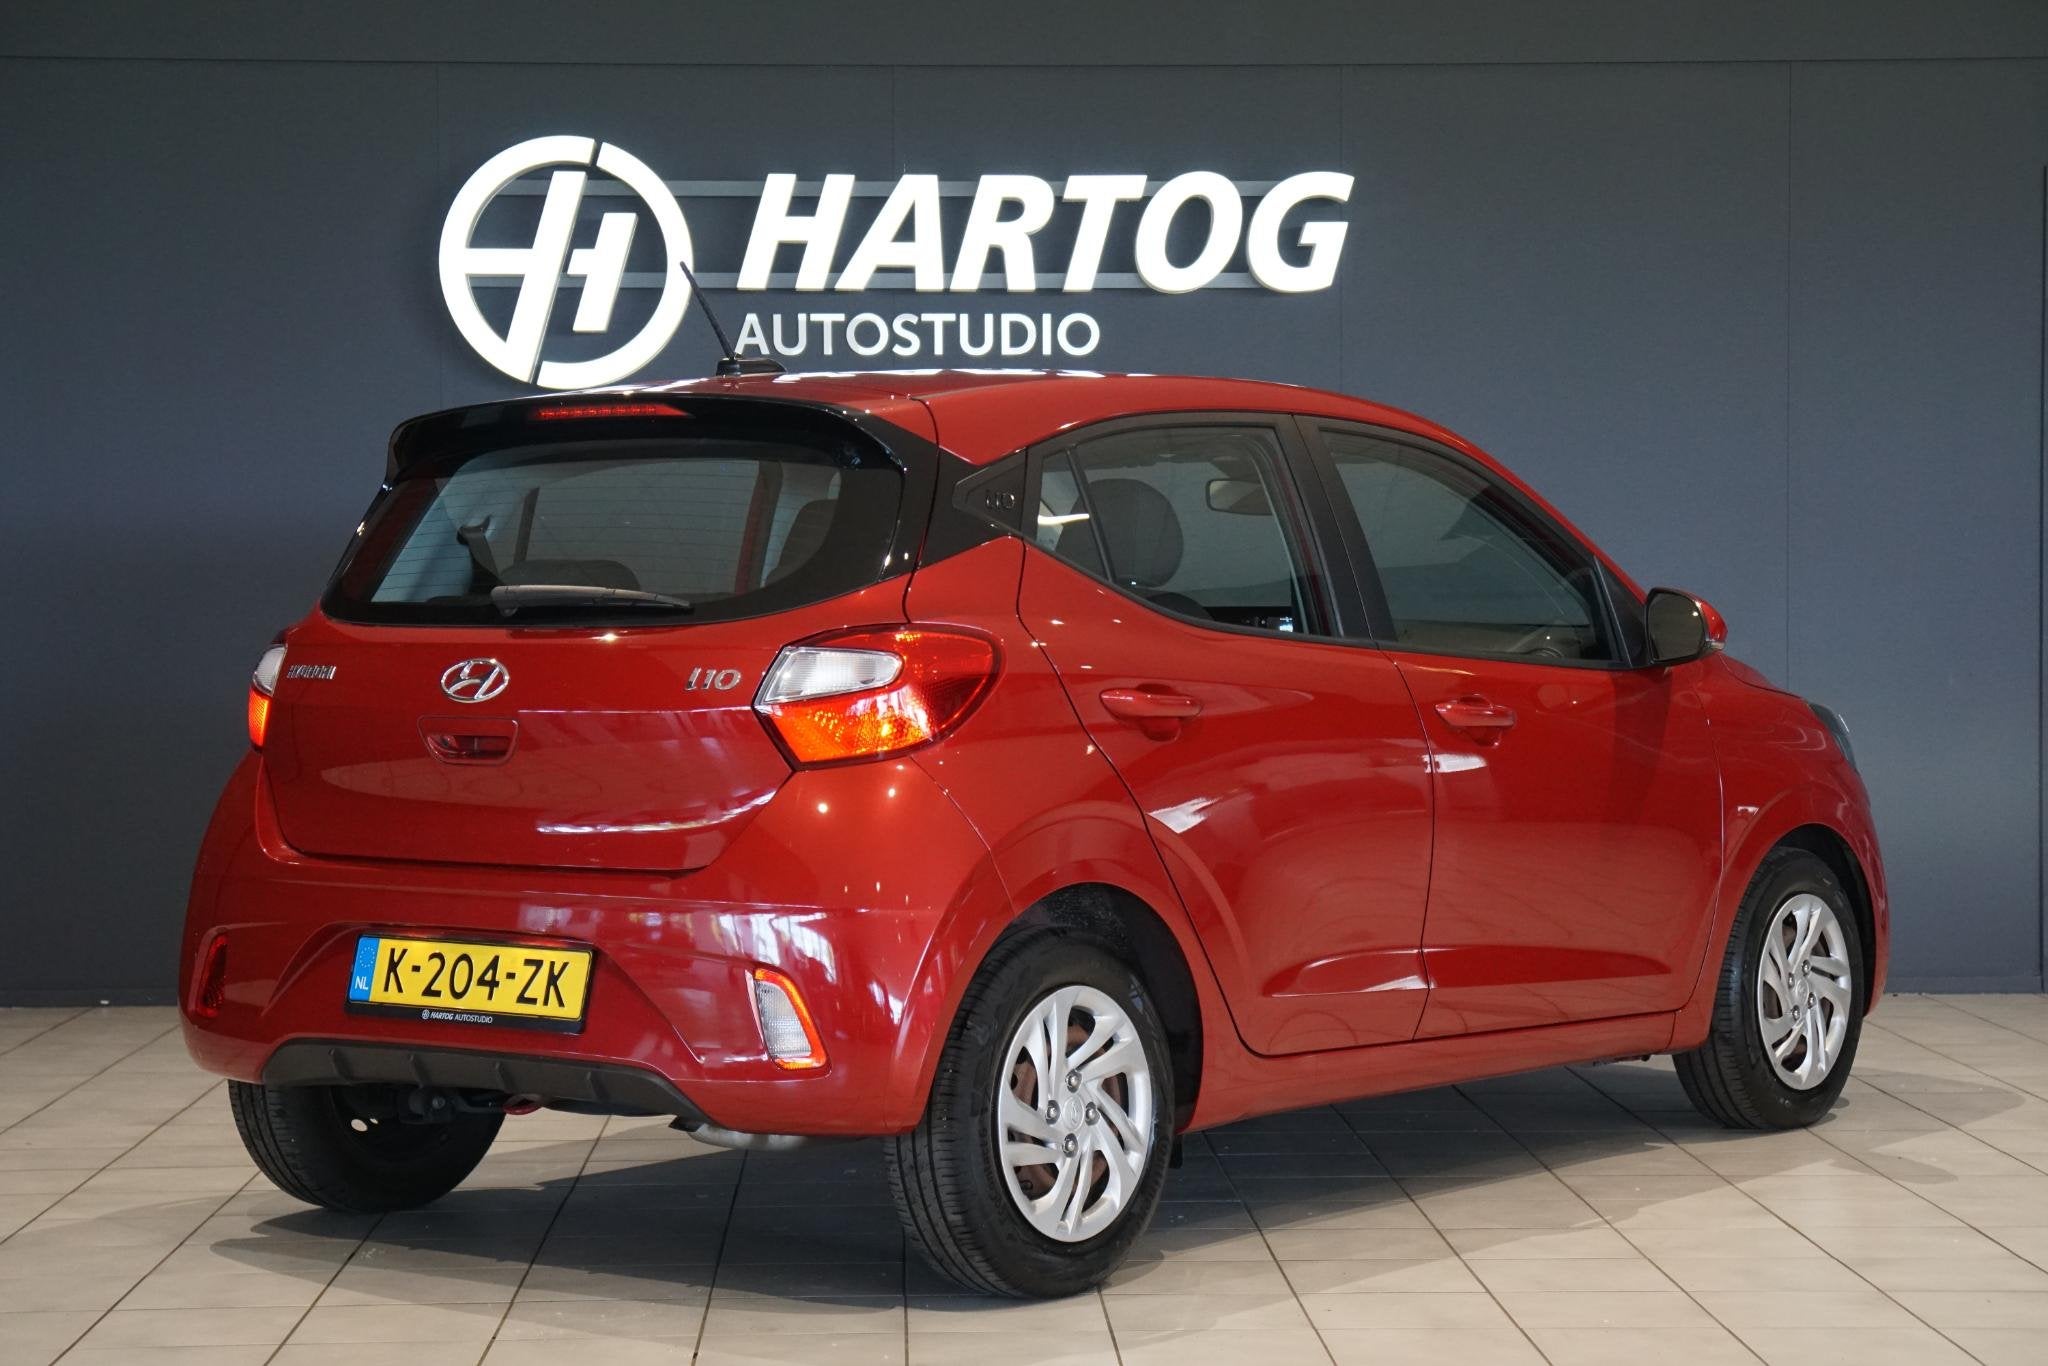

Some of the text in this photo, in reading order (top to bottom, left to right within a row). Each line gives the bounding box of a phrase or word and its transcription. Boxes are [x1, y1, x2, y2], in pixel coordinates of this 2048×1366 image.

[736, 170, 1356, 293] HARTOG
[735, 311, 1101, 358] AUTOSTUDIO
[354, 975, 369, 991] NL
[383, 947, 570, 1008] K-204-ZK
[430, 1011, 493, 1024] HARTOG AUTOSTUDIO
